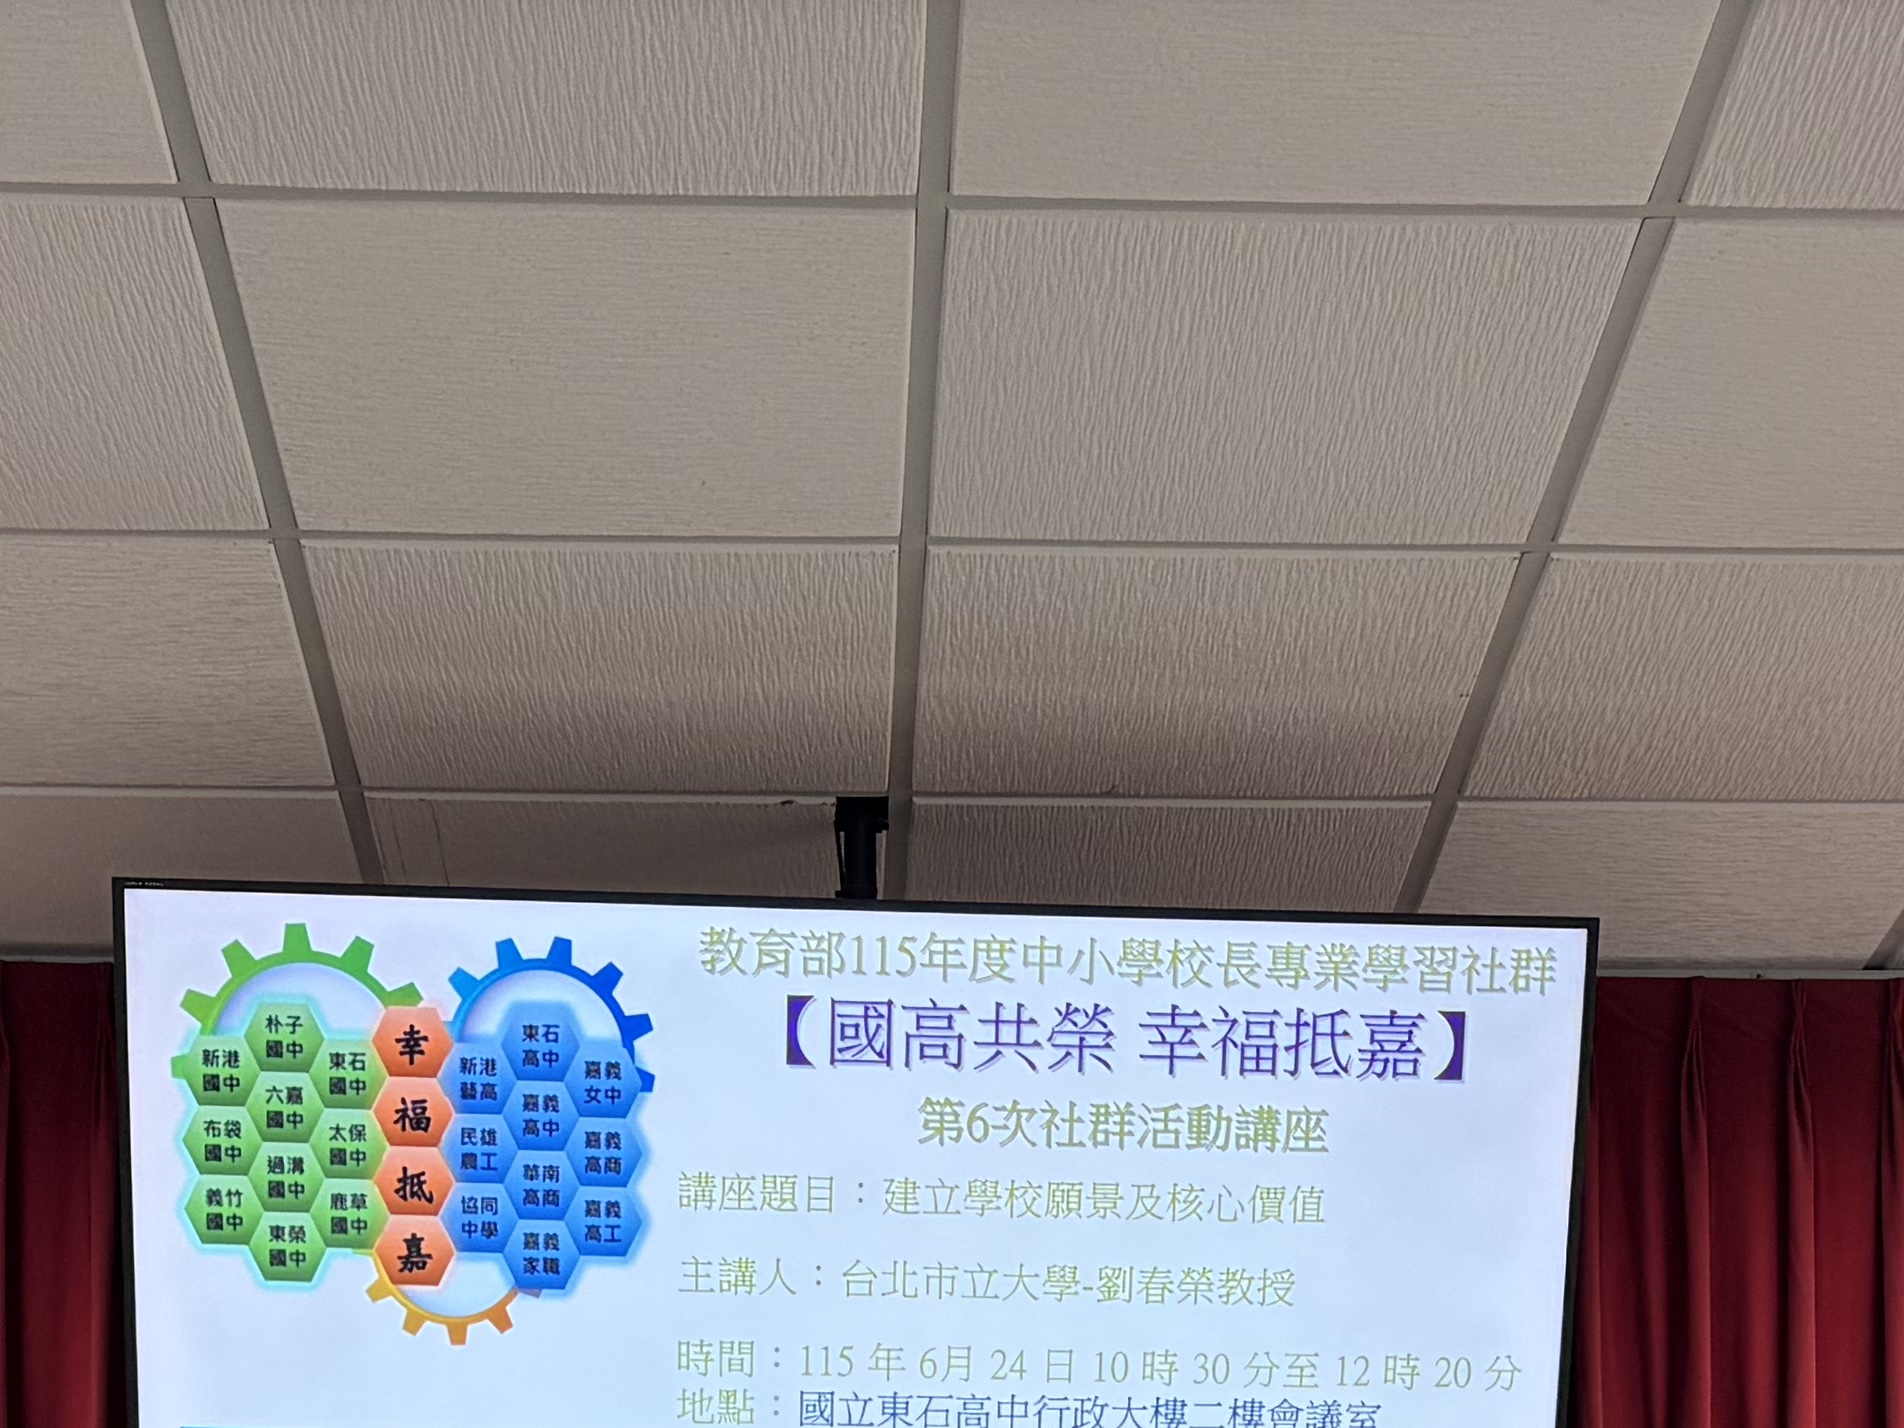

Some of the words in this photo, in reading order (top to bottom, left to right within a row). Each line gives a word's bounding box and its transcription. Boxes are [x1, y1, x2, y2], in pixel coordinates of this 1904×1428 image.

[699, 926, 1558, 997] 教育部115年度中小學校長專業學習社群
[521, 1024, 560, 1044] 東石
[785, 992, 1117, 1076] 【國高共榮
[1137, 1003, 1467, 1083] 幸福抵嘉】
[202, 1048, 241, 1069] 新港
[266, 1040, 304, 1059] 國中
[522, 1049, 559, 1070] 高中
[328, 1052, 367, 1073] 東石
[459, 1056, 498, 1077] 新港
[584, 1061, 622, 1081] 嘉義
[202, 1073, 241, 1093] 國中
[329, 1076, 366, 1097] 國中
[522, 1093, 560, 1114] 嘉義
[583, 1084, 622, 1105] 女中
[202, 1119, 242, 1140] 布袋
[266, 1110, 304, 1130] 國中
[522, 1118, 560, 1139] 高中
[918, 1096, 1329, 1156] 第6次社群活動講座
[329, 1123, 367, 1144] 太保
[460, 1127, 498, 1147] 民雄
[584, 1131, 622, 1152] 嘉義
[204, 1144, 242, 1164] 國中
[329, 1147, 367, 1167] 國中
[584, 1156, 622, 1176] 高商
[267, 1180, 305, 1200] 國中
[523, 1189, 560, 1208] 高商
[678, 1171, 1326, 1226] 講座題目：建立學校願景及核心價值
[584, 1200, 622, 1220] 嘉義
[205, 1212, 244, 1232] 國中
[330, 1216, 368, 1236] 國中
[584, 1224, 621, 1245] 高工
[269, 1249, 307, 1269] 國中
[678, 1256, 1297, 1307] 主講人：台北市立大學-劉春榮教授
[677, 1338, 854, 1380] 時間：115
[868, 1343, 907, 1383] 年
[990, 1350, 1028, 1383] 24
[1047, 1349, 1073, 1386] 日
[1094, 1353, 1130, 1387] 10
[1142, 1350, 1179, 1388] 時
[1194, 1355, 1231, 1388] 30
[1243, 1352, 1320, 1391] 分至
[1337, 1358, 1372, 1390] 12
[1383, 1354, 1420, 1392] 時
[1435, 1359, 1472, 1392] 20
[1485, 1355, 1523, 1393] 分
